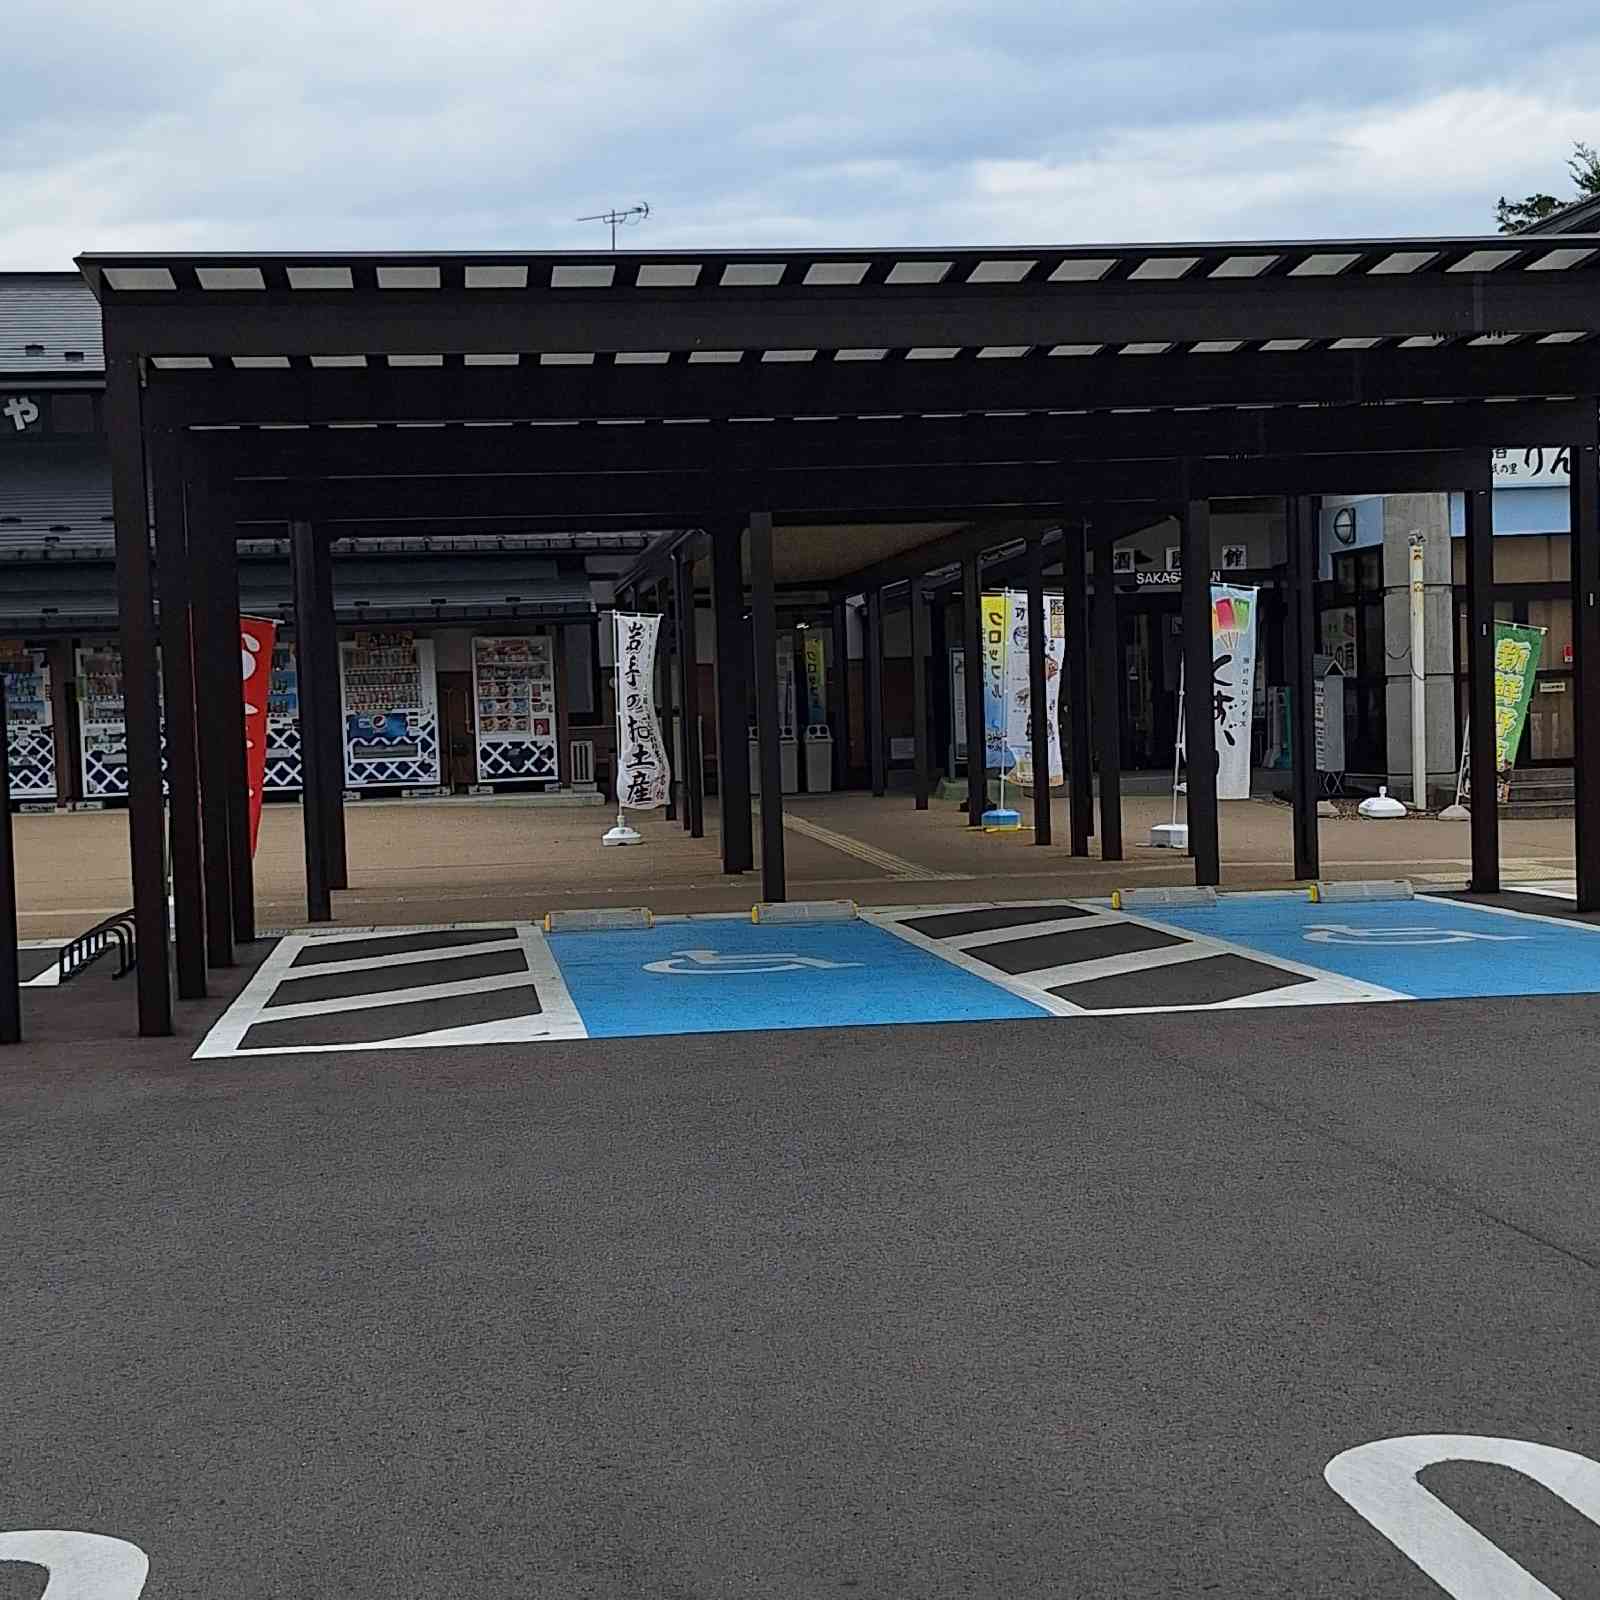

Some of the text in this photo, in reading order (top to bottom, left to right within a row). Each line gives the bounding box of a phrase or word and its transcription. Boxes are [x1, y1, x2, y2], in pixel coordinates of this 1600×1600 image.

[4, 398, 38, 430] や
[625, 622, 655, 805] 岩手のお土産
